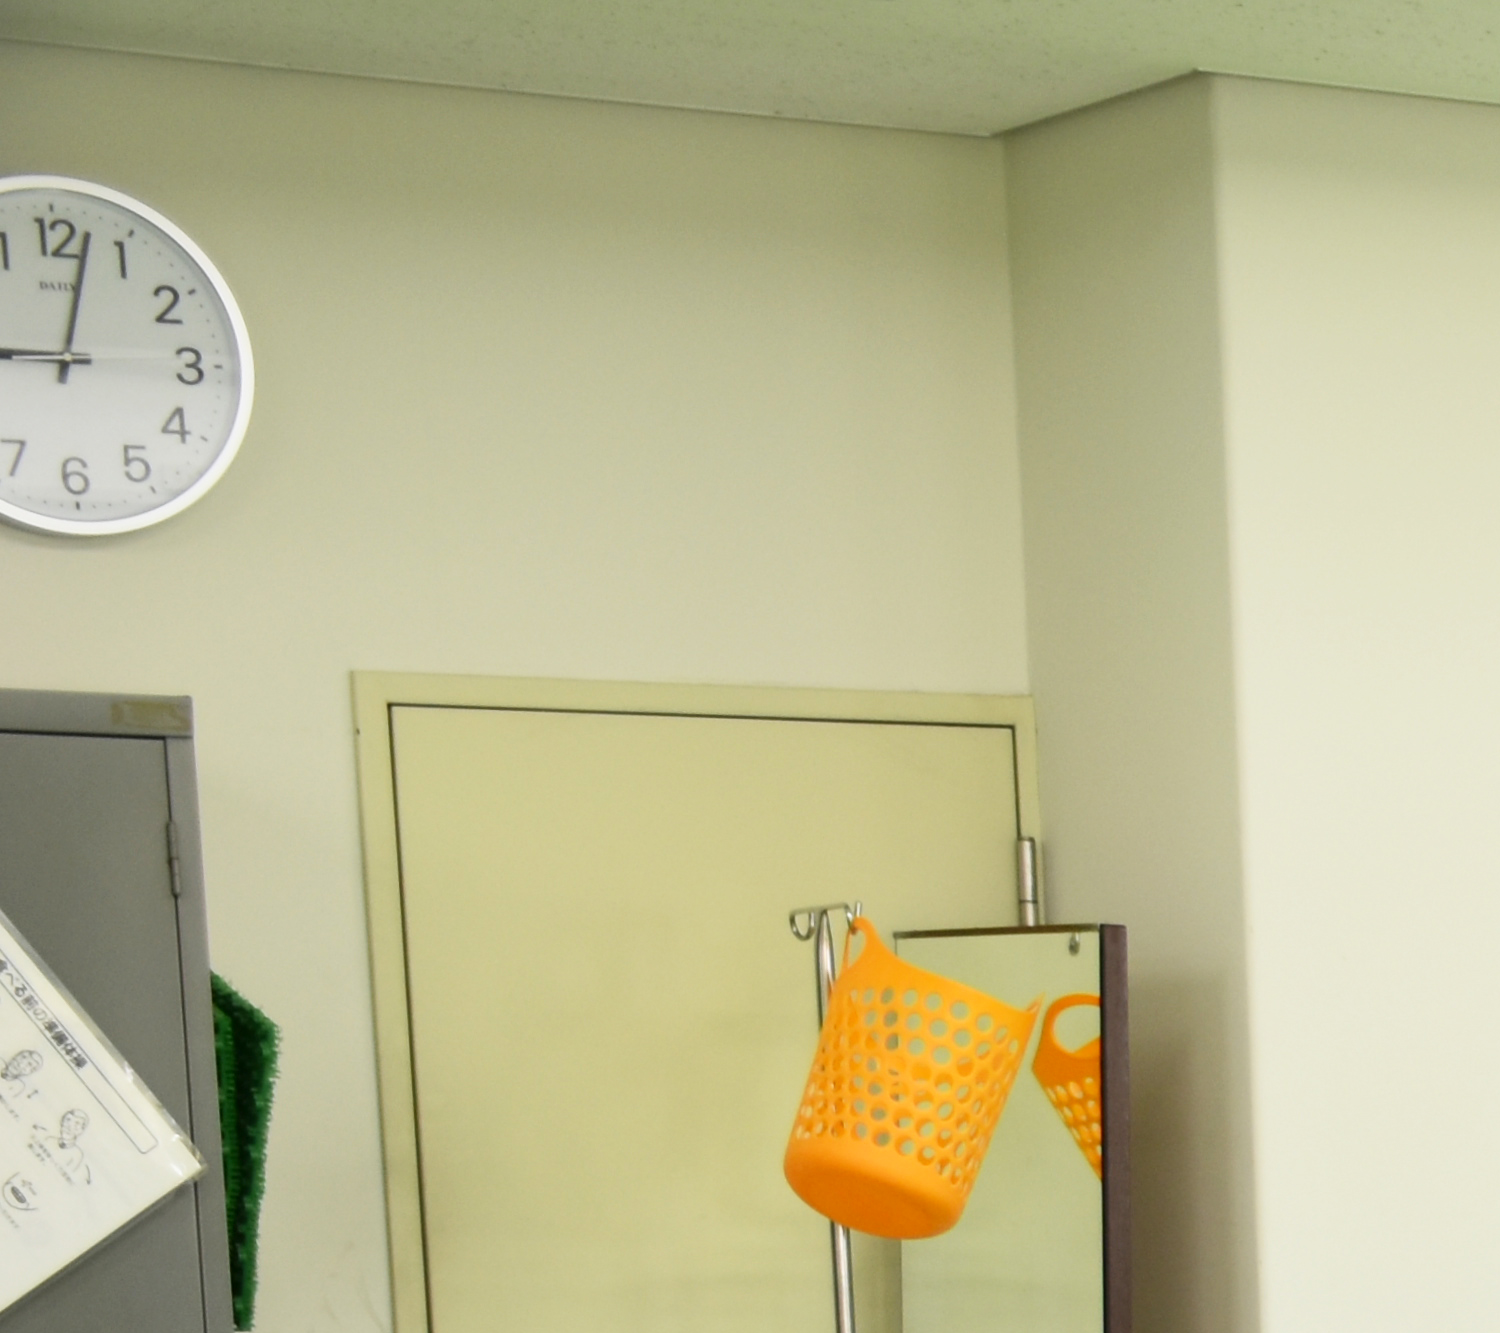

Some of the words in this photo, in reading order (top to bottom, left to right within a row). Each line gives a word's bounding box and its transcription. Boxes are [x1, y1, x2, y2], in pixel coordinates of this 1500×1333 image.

[34, 218, 80, 259] 12
[114, 240, 127, 280] 1
[153, 285, 184, 325] 2
[175, 347, 205, 385] 3
[161, 406, 192, 444] 4
[0, 438, 27, 477] 7
[61, 456, 90, 496] 6
[123, 444, 152, 483] 5
